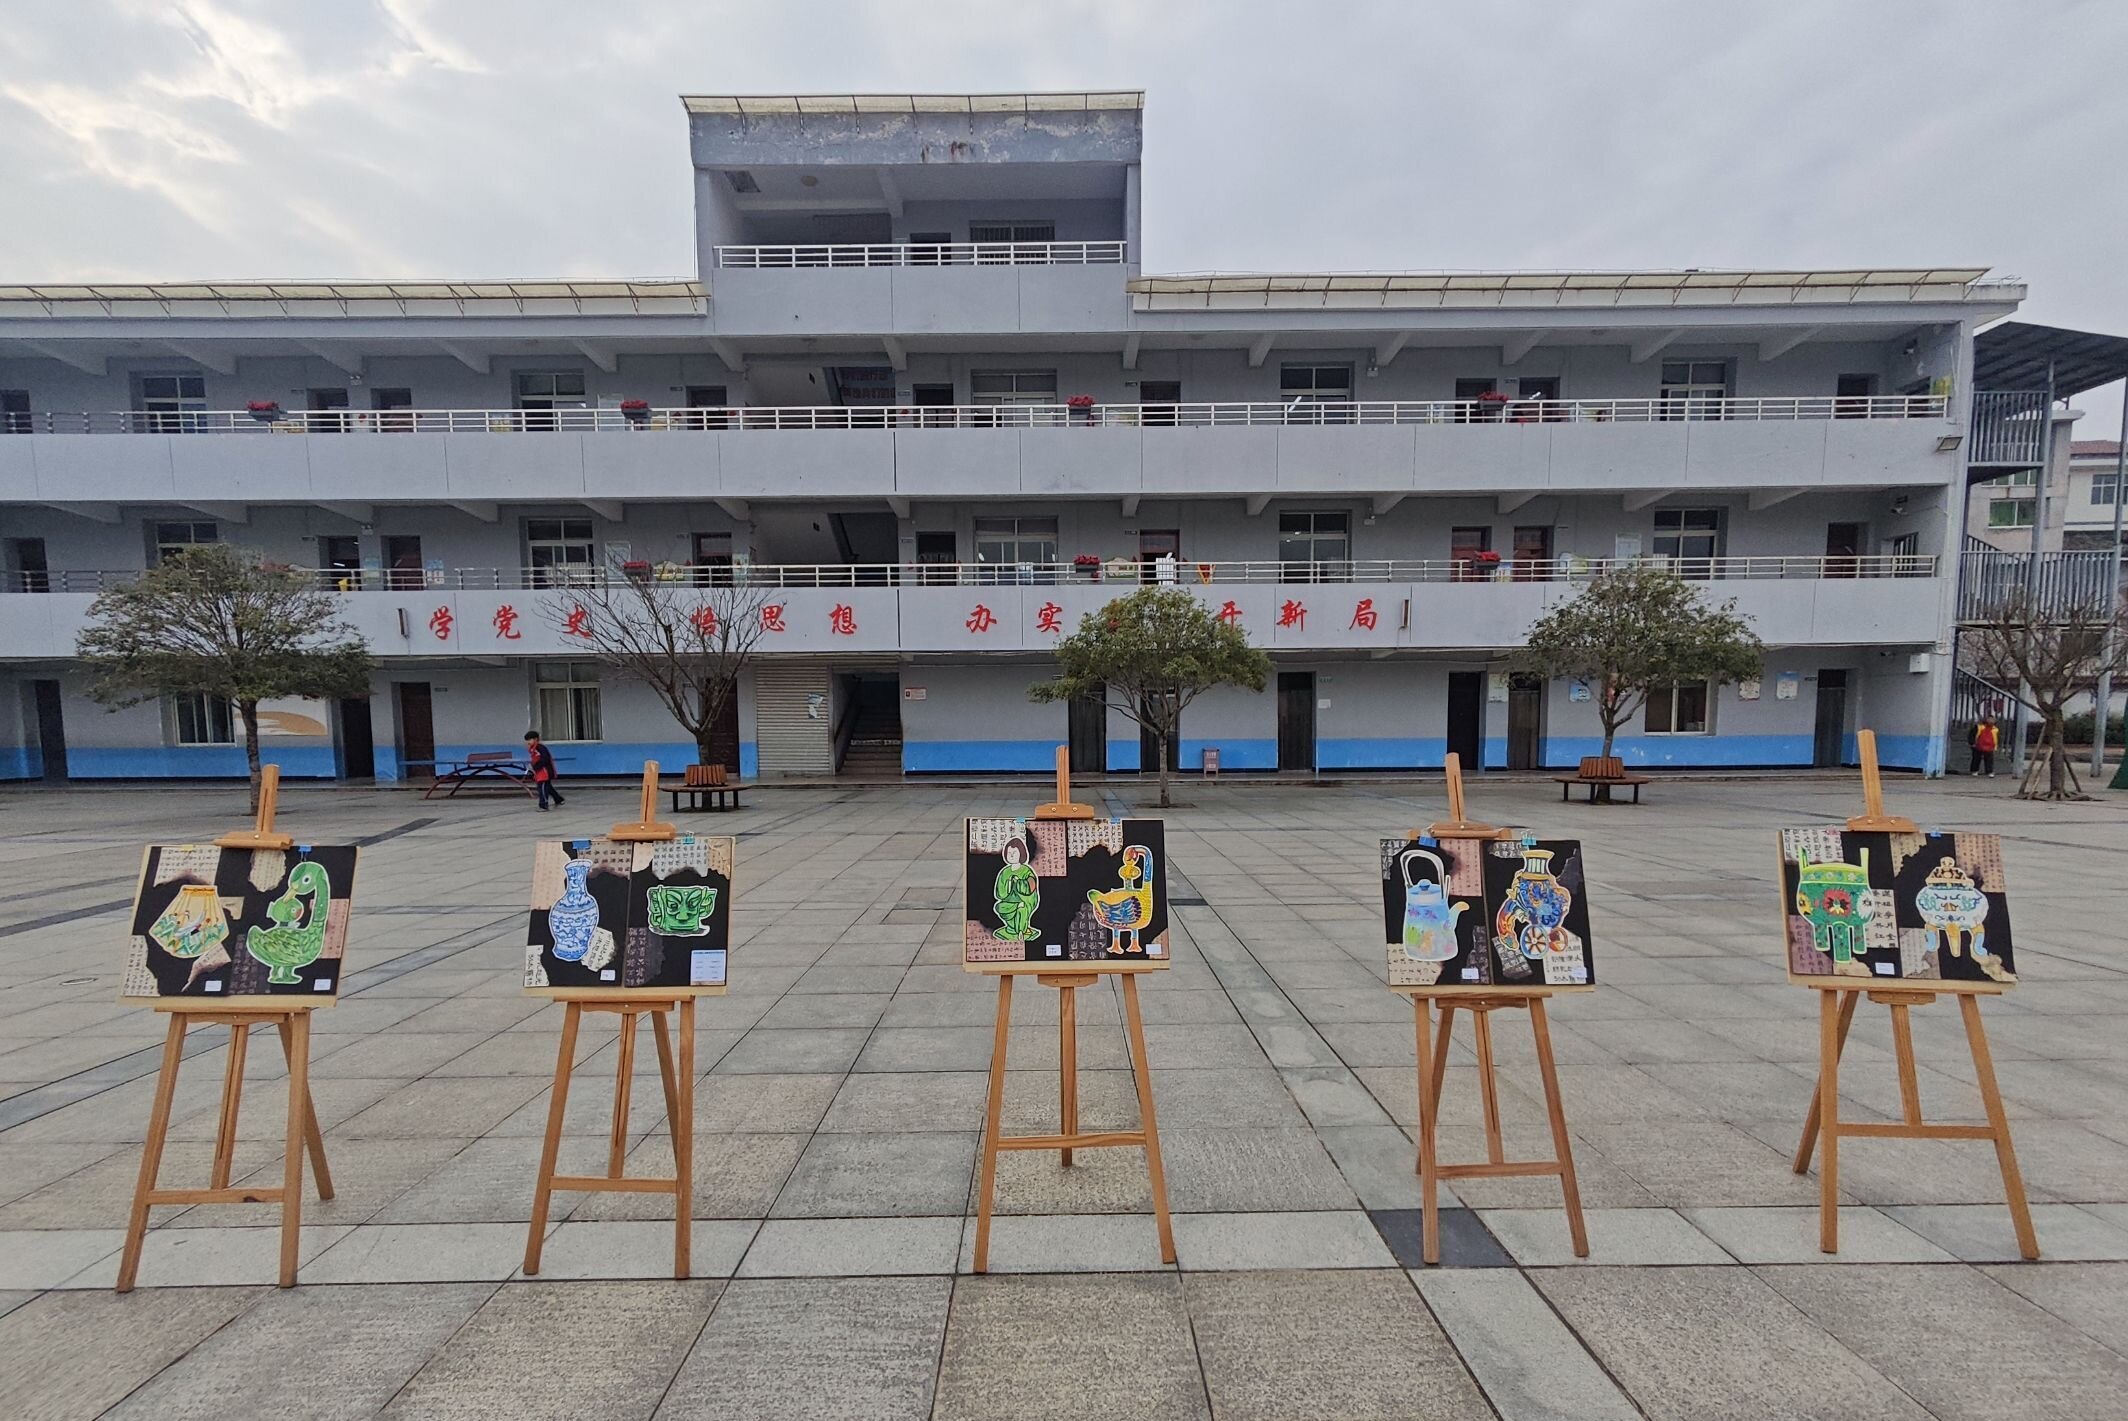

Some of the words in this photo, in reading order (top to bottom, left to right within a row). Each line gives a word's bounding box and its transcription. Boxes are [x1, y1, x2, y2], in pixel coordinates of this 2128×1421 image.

[690, 603, 858, 637] 悟思想
[1217, 598, 1378, 632] 开新局
